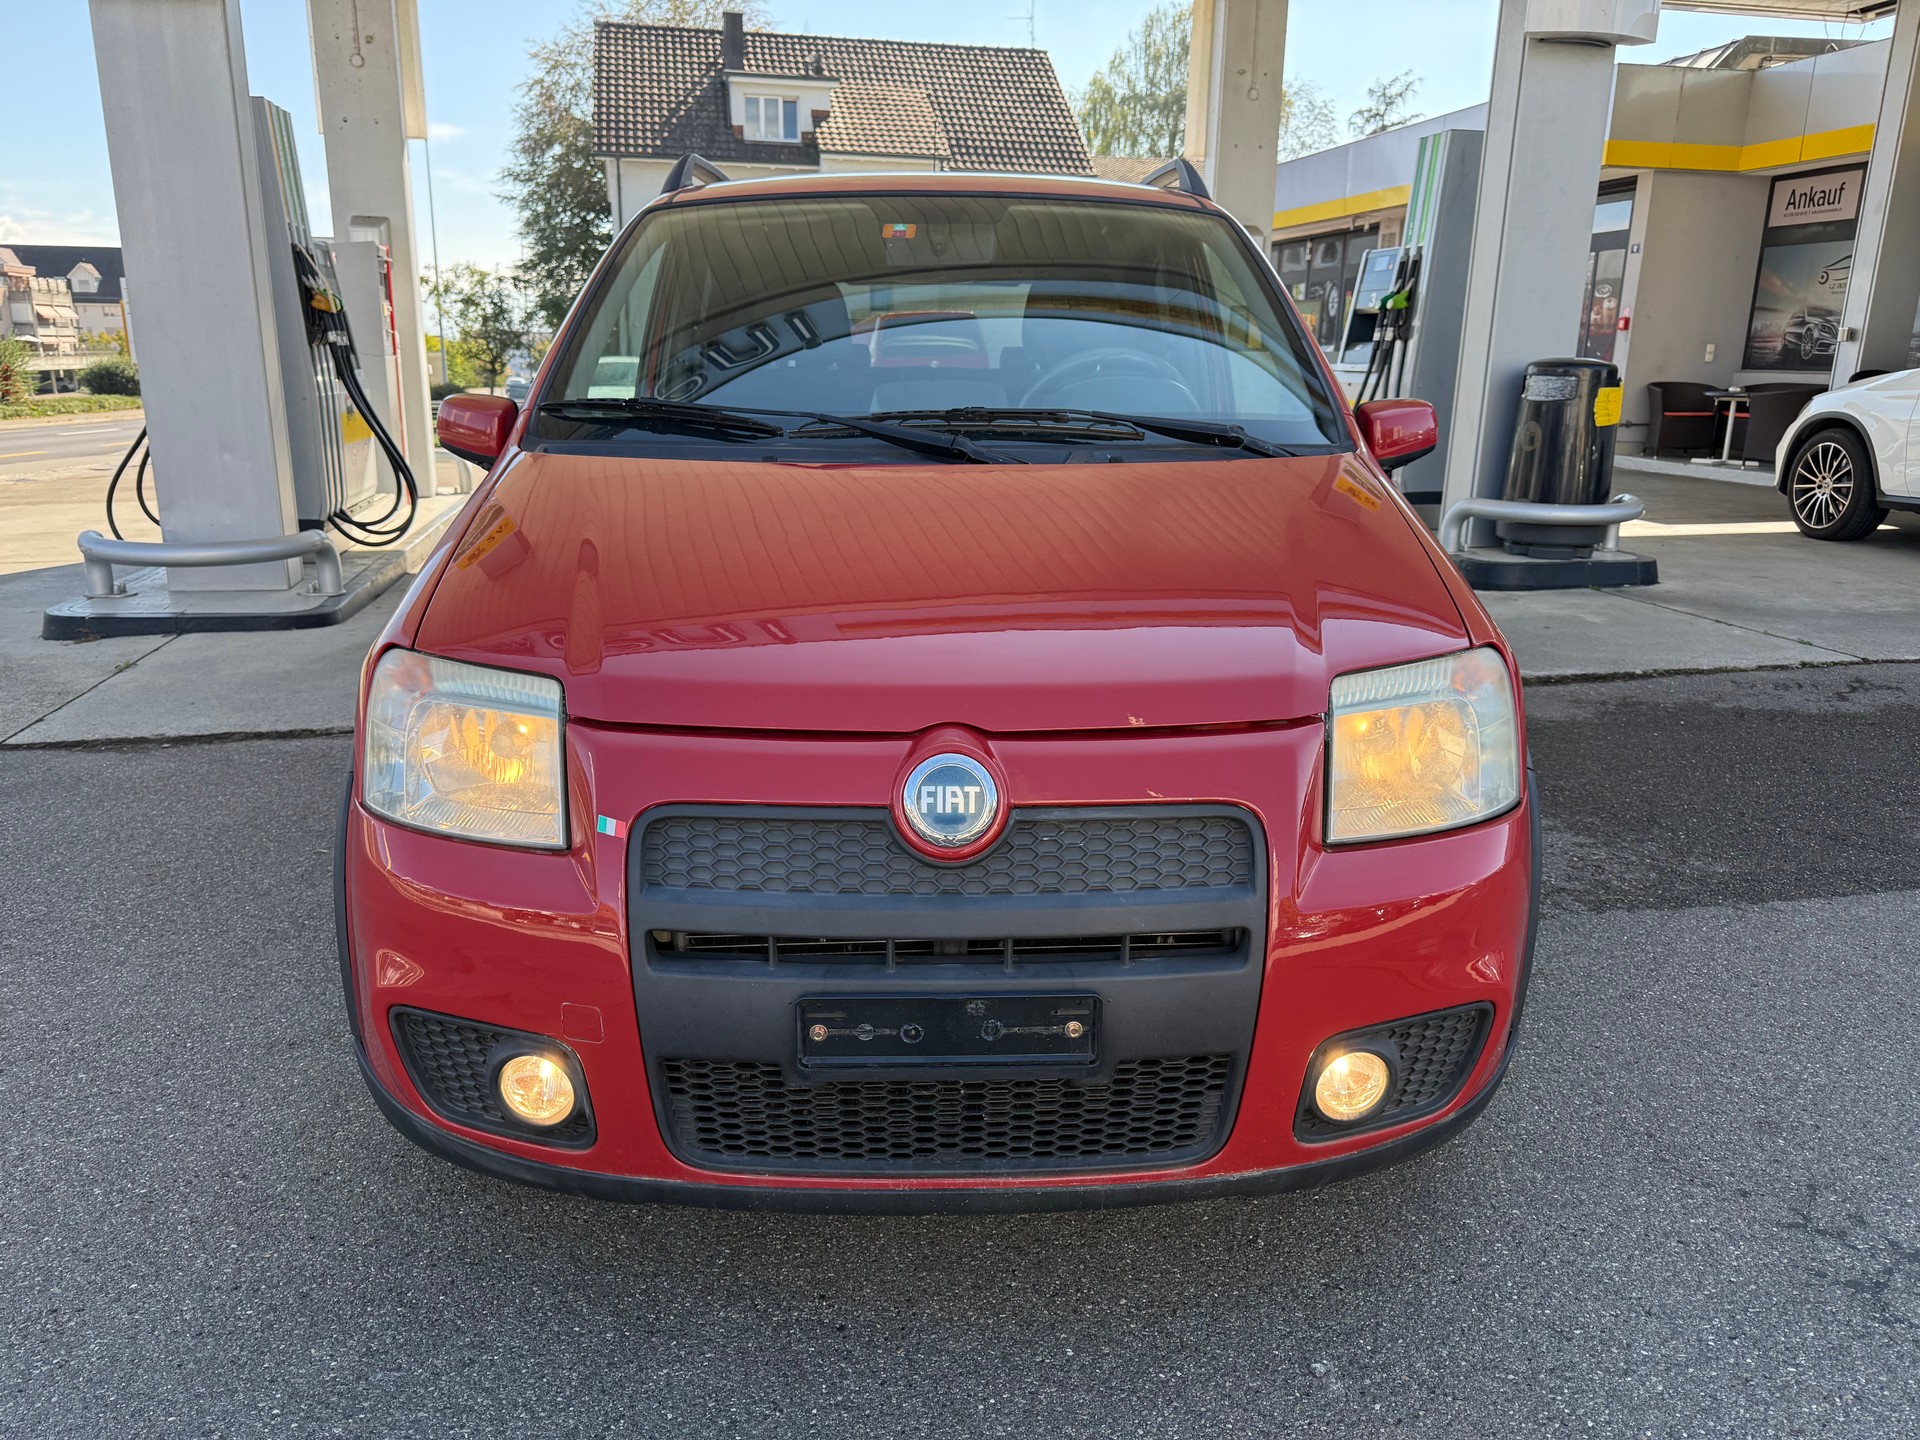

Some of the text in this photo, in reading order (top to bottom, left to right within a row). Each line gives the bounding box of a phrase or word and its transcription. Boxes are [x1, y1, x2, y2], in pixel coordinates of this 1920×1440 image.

[1784, 181, 1846, 211] Ankauf
[1368, 292, 1377, 308] 3
[920, 785, 981, 814] FIAT
